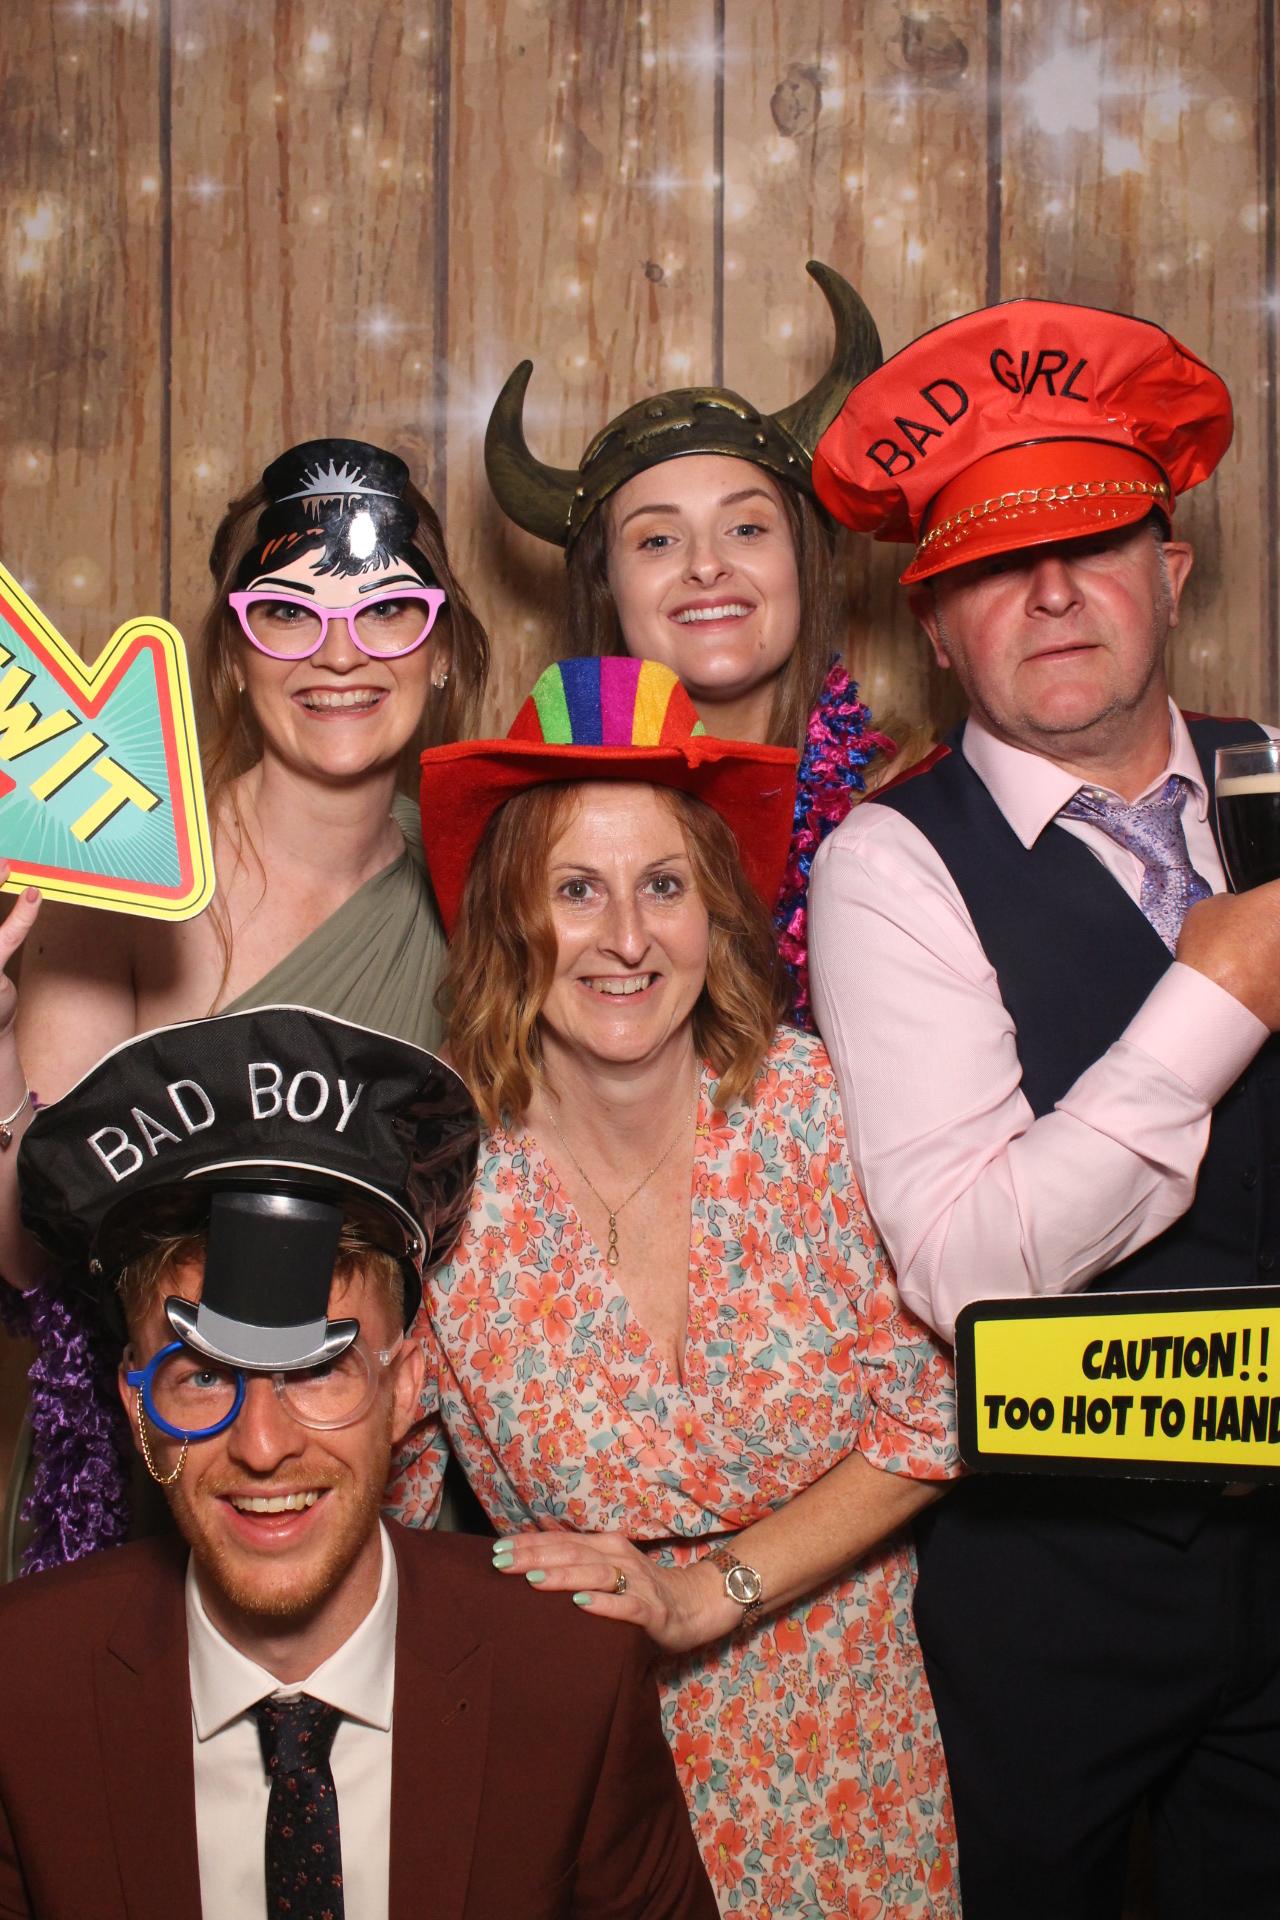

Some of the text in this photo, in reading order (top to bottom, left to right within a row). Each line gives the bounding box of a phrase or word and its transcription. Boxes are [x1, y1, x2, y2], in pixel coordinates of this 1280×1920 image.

[866, 348, 1089, 477] BAD GIRL
[0, 643, 163, 843] WIT
[87, 1062, 365, 1183] BAD BOY
[1082, 1326, 1270, 1383] CAUTION!!
[984, 1395, 1055, 1431] TOO
[1062, 1395, 1134, 1436] HOT
[1141, 1396, 1186, 1438] TO
